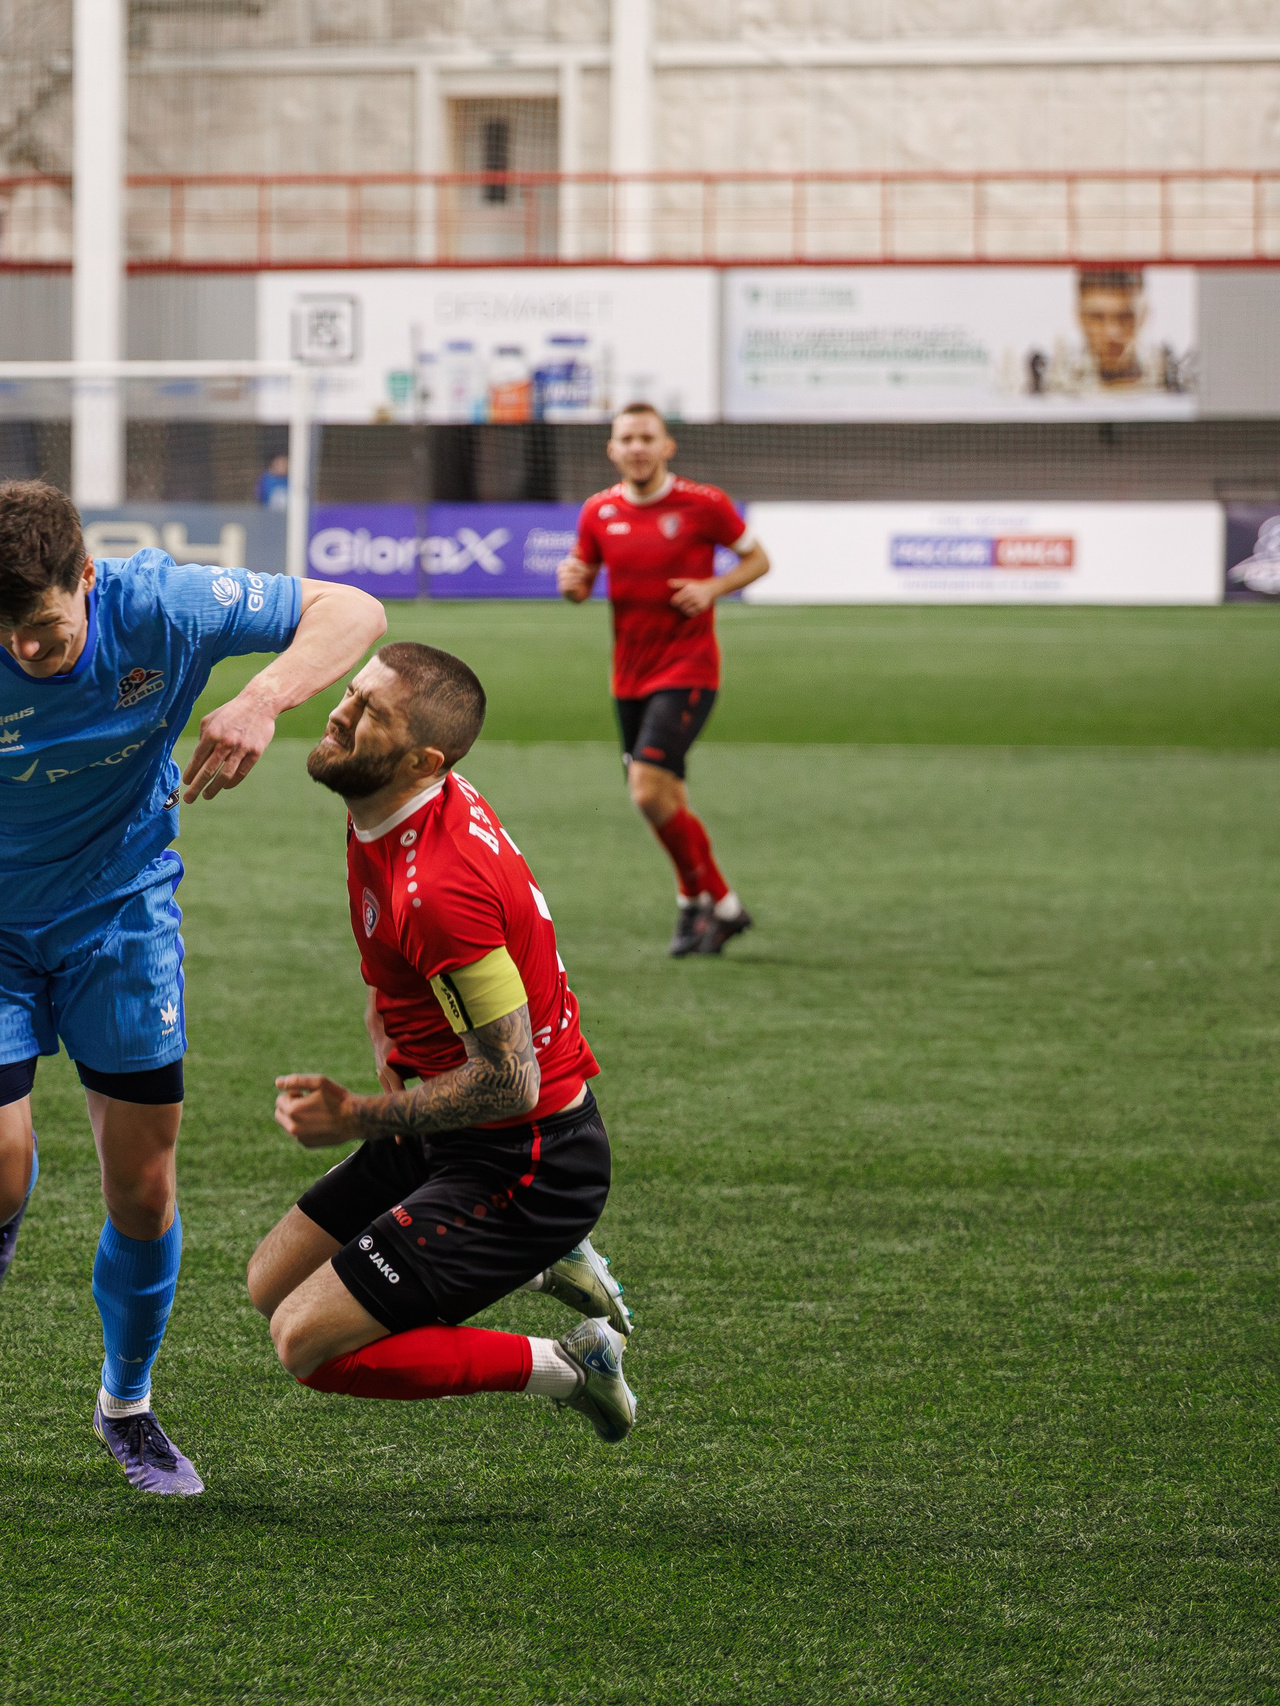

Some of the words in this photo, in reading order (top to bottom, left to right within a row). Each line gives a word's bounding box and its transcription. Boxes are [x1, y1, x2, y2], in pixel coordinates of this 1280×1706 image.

[308, 525, 513, 576] GloraX
[440, 986, 460, 1019] JAKO
[368, 1251, 401, 1285] JAKO
